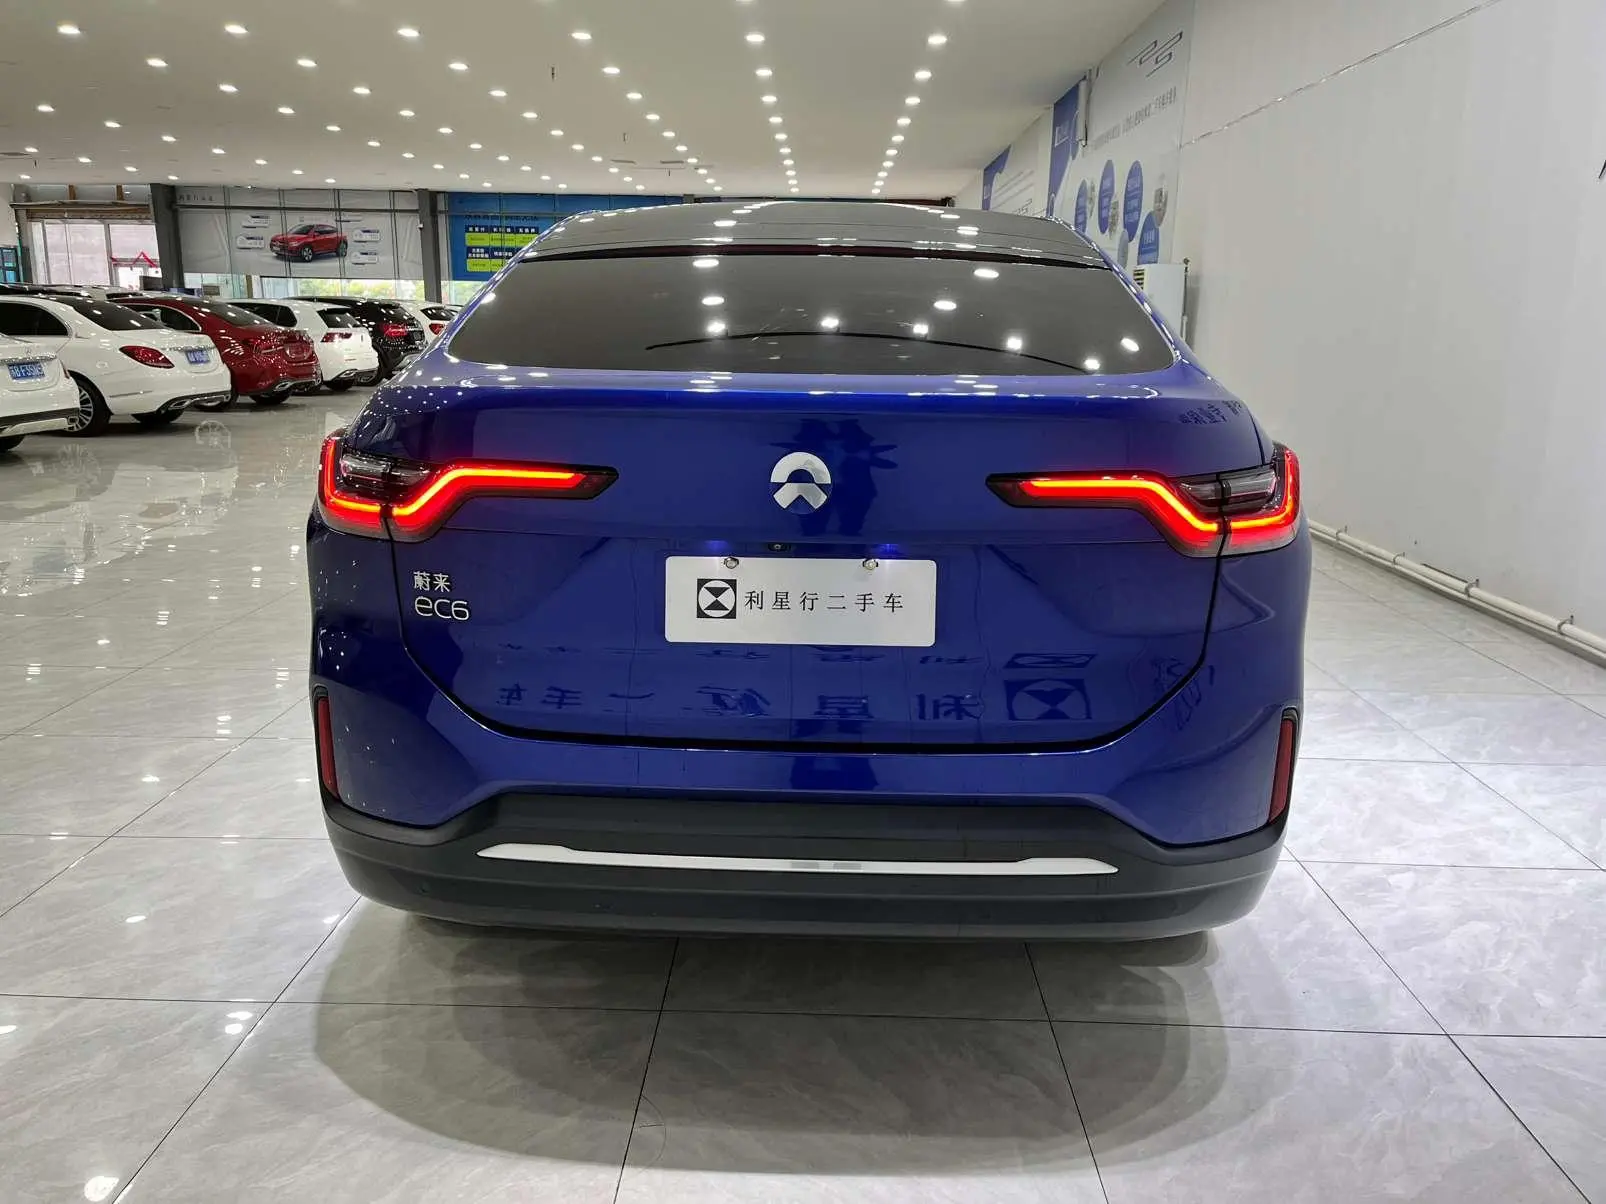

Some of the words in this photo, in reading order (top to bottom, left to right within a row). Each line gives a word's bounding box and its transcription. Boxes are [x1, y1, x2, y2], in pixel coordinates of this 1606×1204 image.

[413, 571, 450, 592] 蔚来
[744, 590, 904, 613] 利星行二手车
